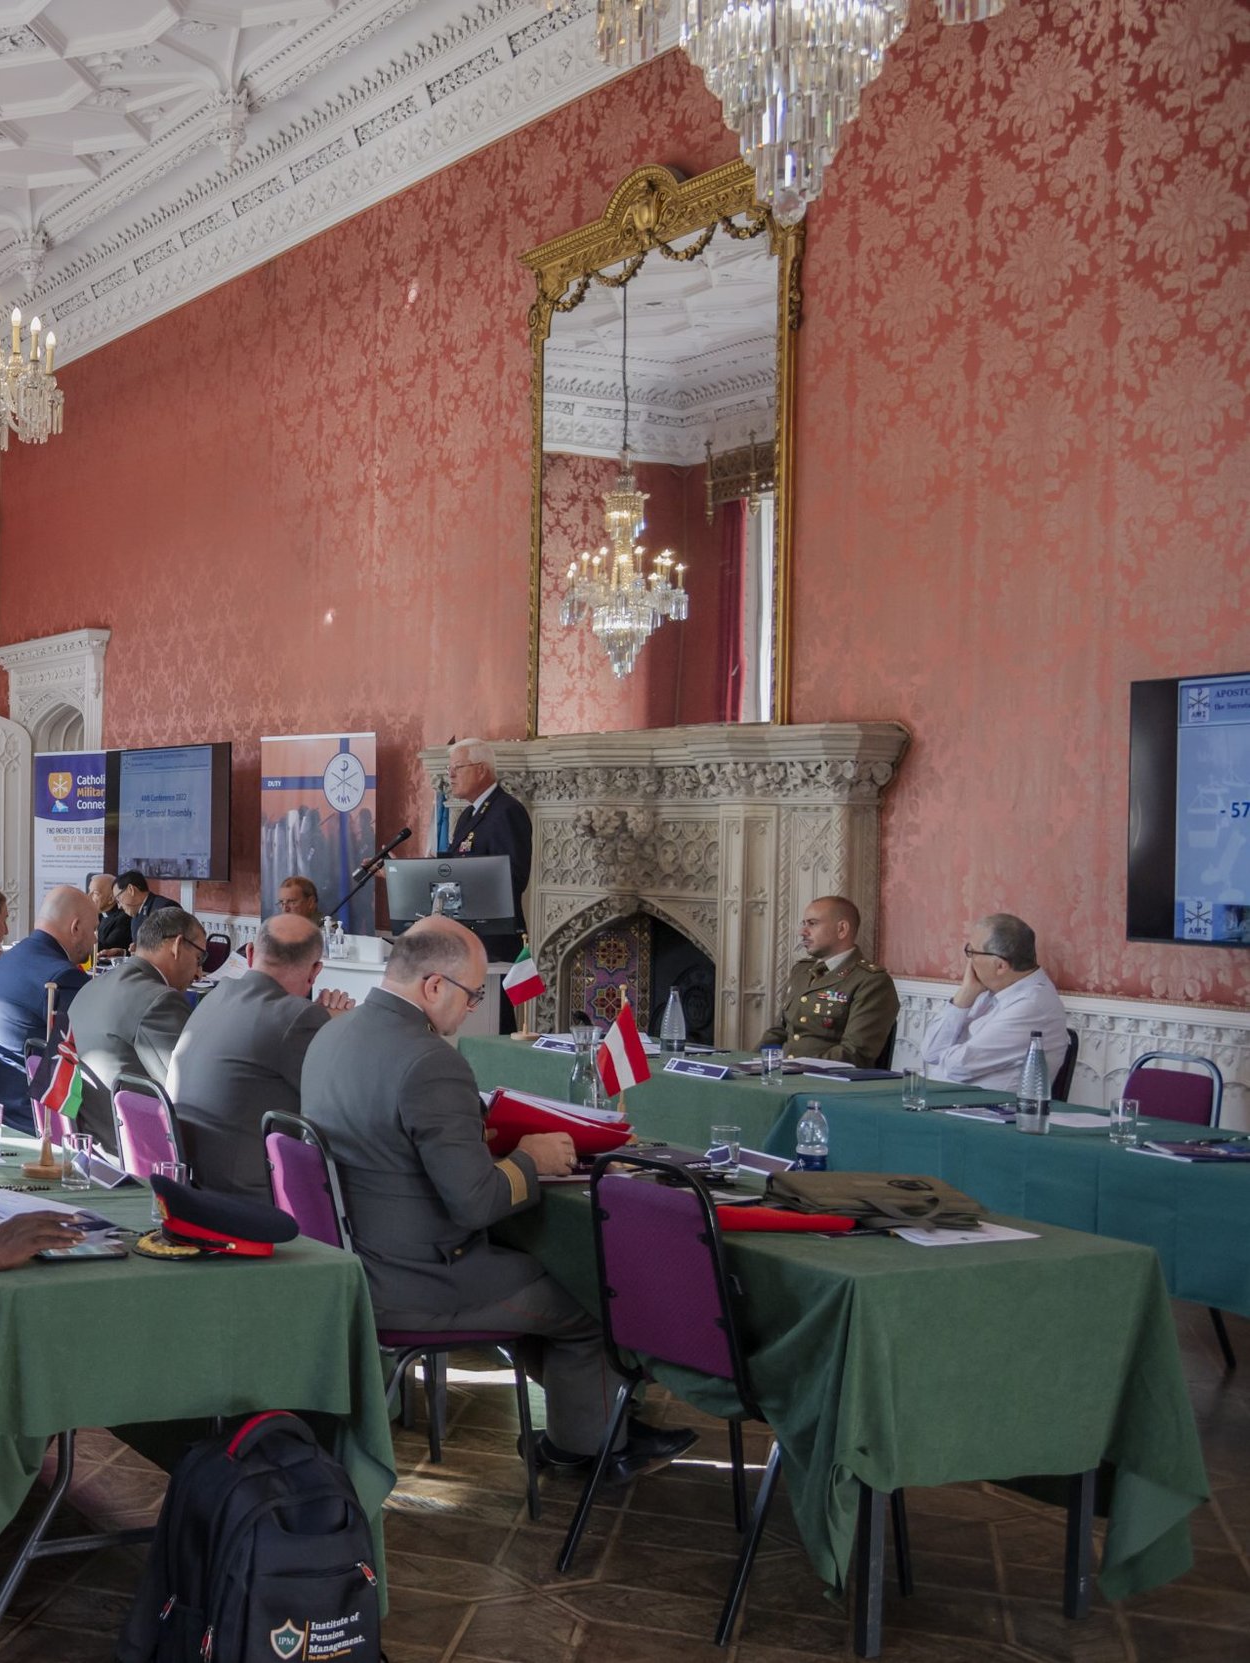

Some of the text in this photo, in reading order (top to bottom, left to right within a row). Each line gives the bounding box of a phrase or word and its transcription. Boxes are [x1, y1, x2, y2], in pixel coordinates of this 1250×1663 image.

[311, 1611, 360, 1631] Institute of
[277, 1636, 295, 1646] IPM
[309, 1629, 345, 1642] Pension
[308, 1634, 366, 1654] Management.
